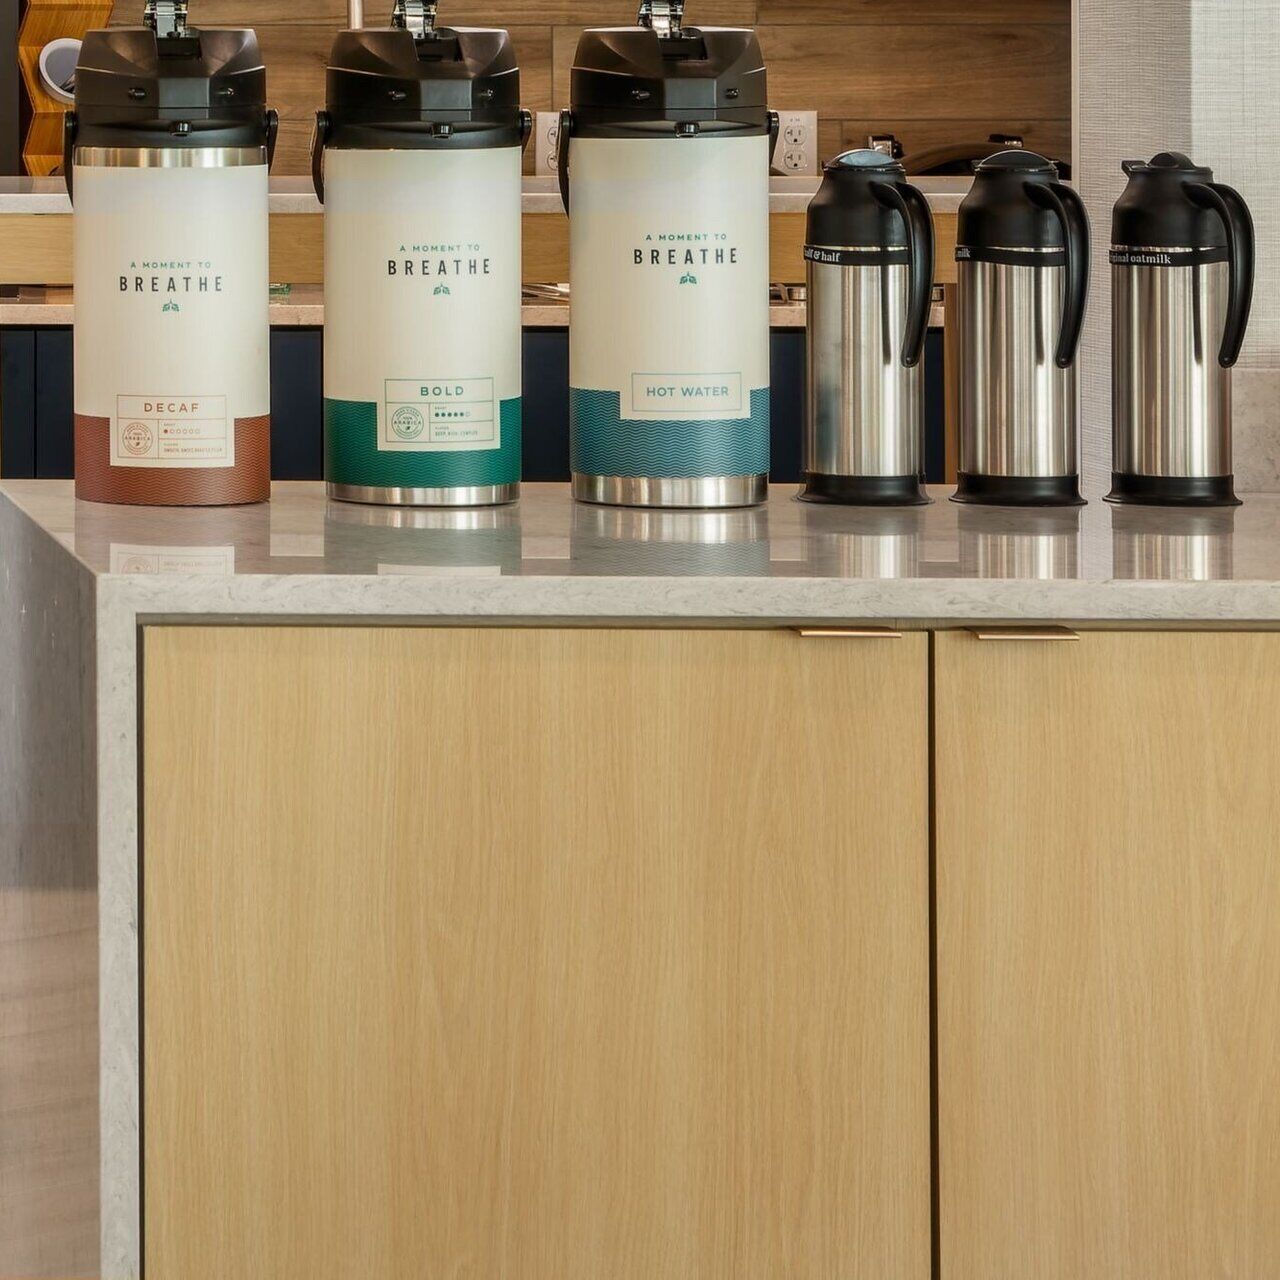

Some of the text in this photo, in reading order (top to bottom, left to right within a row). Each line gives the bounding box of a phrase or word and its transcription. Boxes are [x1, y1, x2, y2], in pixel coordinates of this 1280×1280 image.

[634, 248, 737, 264] BREATHE
[821, 251, 841, 262] half
[1130, 254, 1172, 264] oatmilk
[388, 259, 490, 275] BREATHE
[119, 276, 222, 292] BREATHE
[420, 386, 464, 396] BOLD
[646, 386, 729, 397] HOT WATER
[144, 403, 199, 413] DECAF
